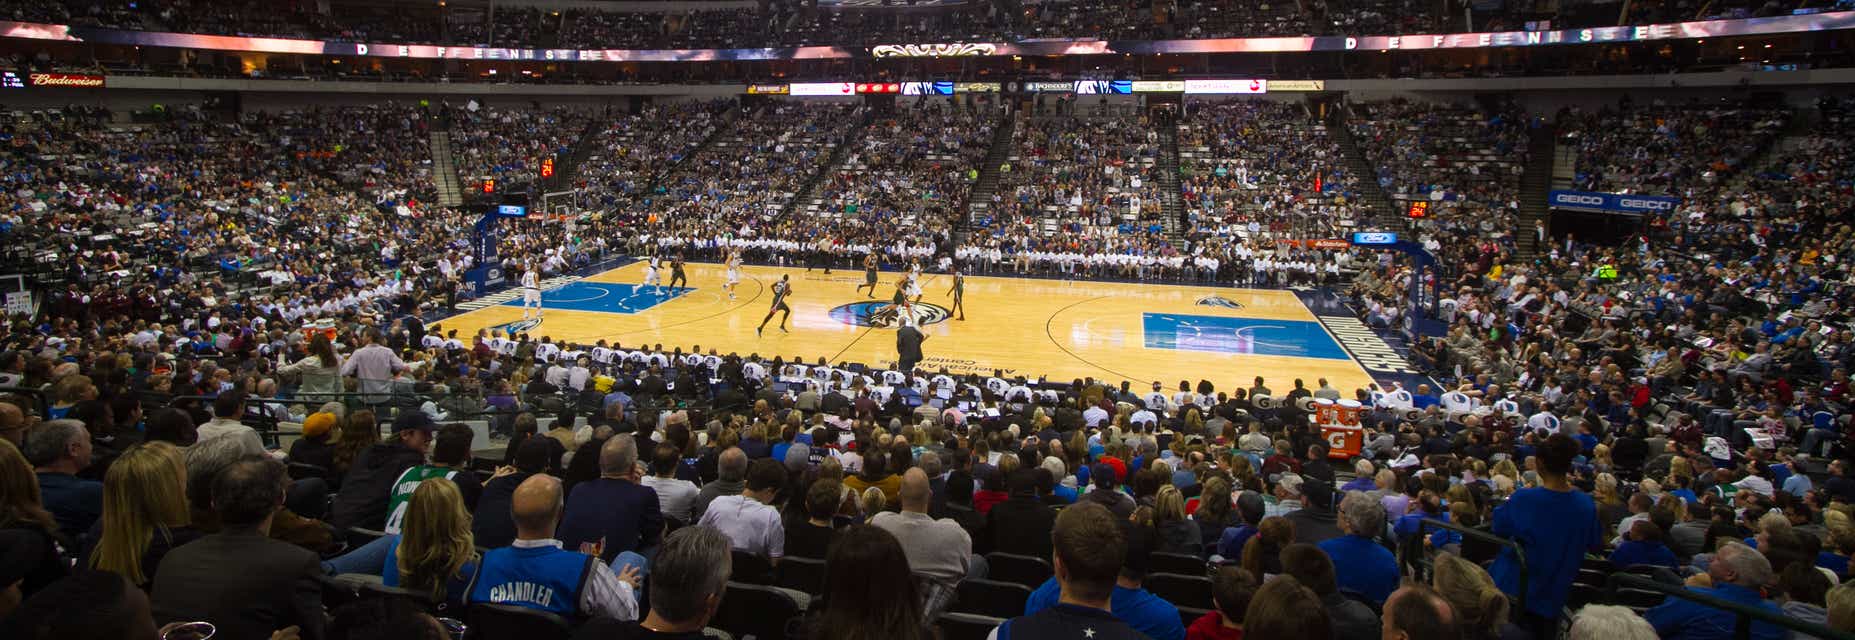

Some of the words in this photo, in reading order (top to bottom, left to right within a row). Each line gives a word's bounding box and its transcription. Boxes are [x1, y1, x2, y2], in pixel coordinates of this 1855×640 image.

[30, 73, 103, 86] Budweiser
[1557, 194, 1603, 205] GEICO
[490, 581, 553, 607] CHANDLER
